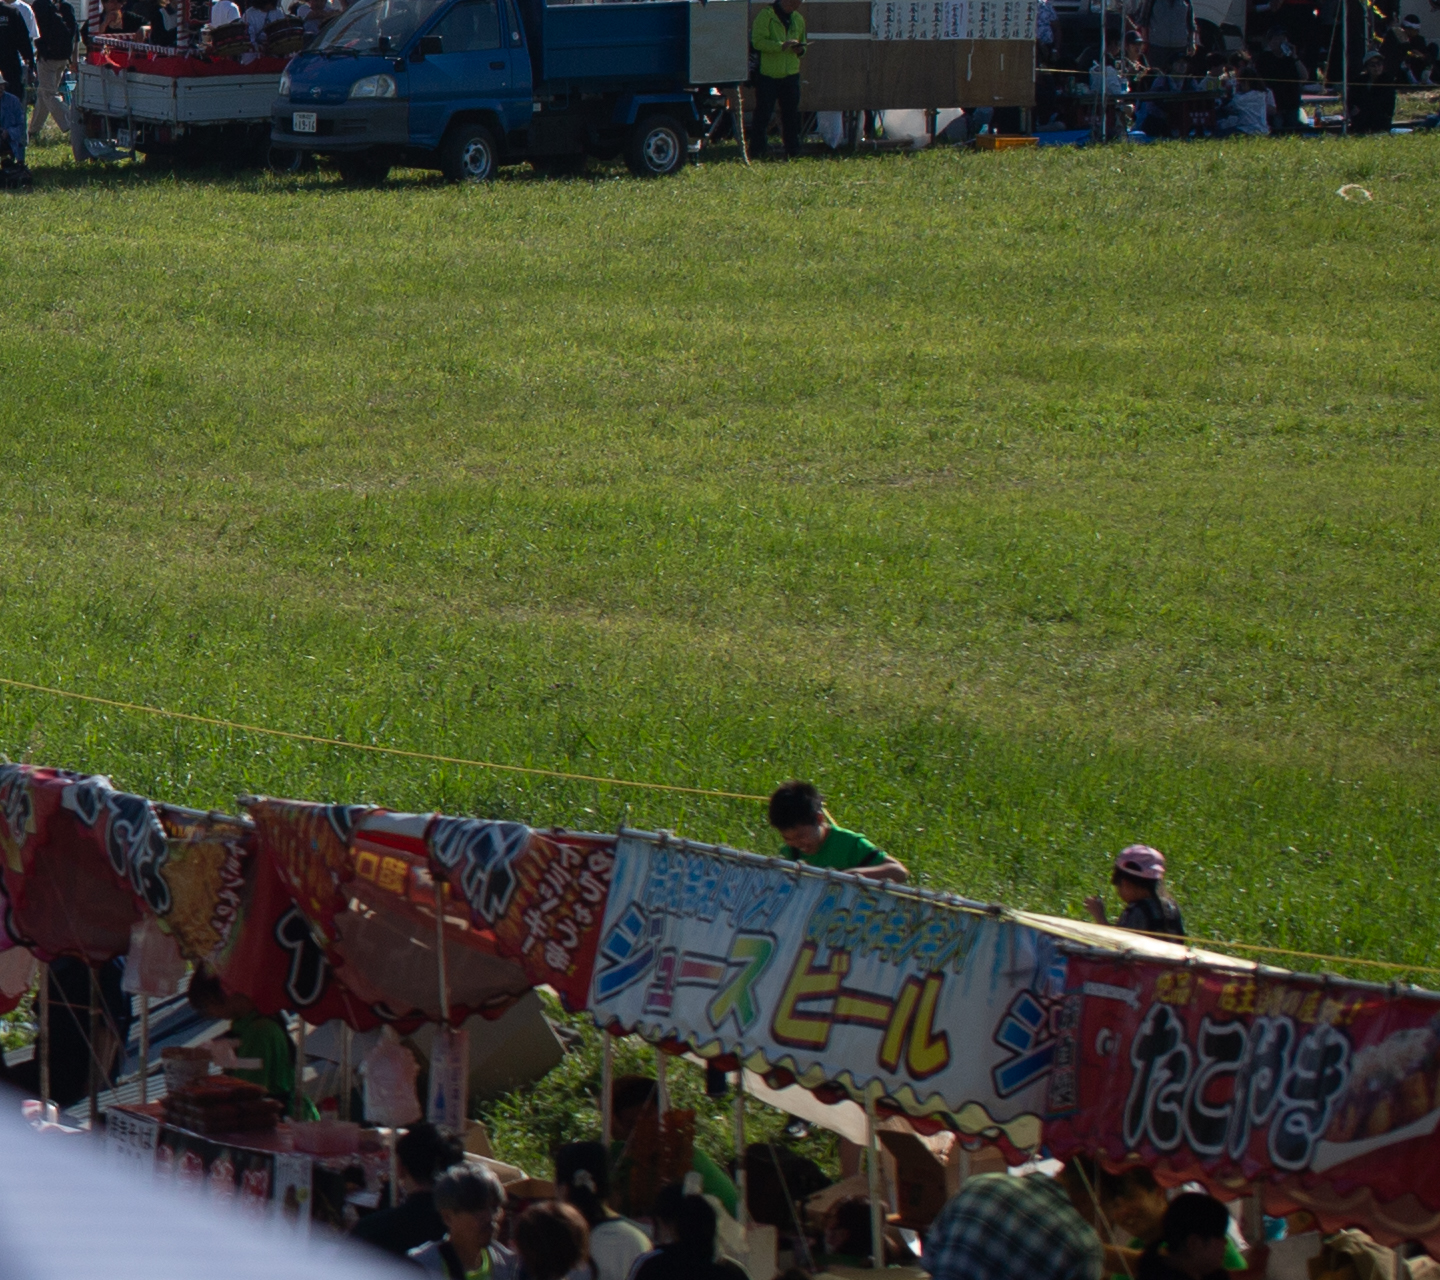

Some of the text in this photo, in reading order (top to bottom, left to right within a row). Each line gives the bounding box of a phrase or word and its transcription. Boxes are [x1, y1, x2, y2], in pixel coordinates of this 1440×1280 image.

[593, 902, 776, 1035] ジュース
[770, 940, 952, 1080] ビール
[1123, 1001, 1352, 1173] たこやき
